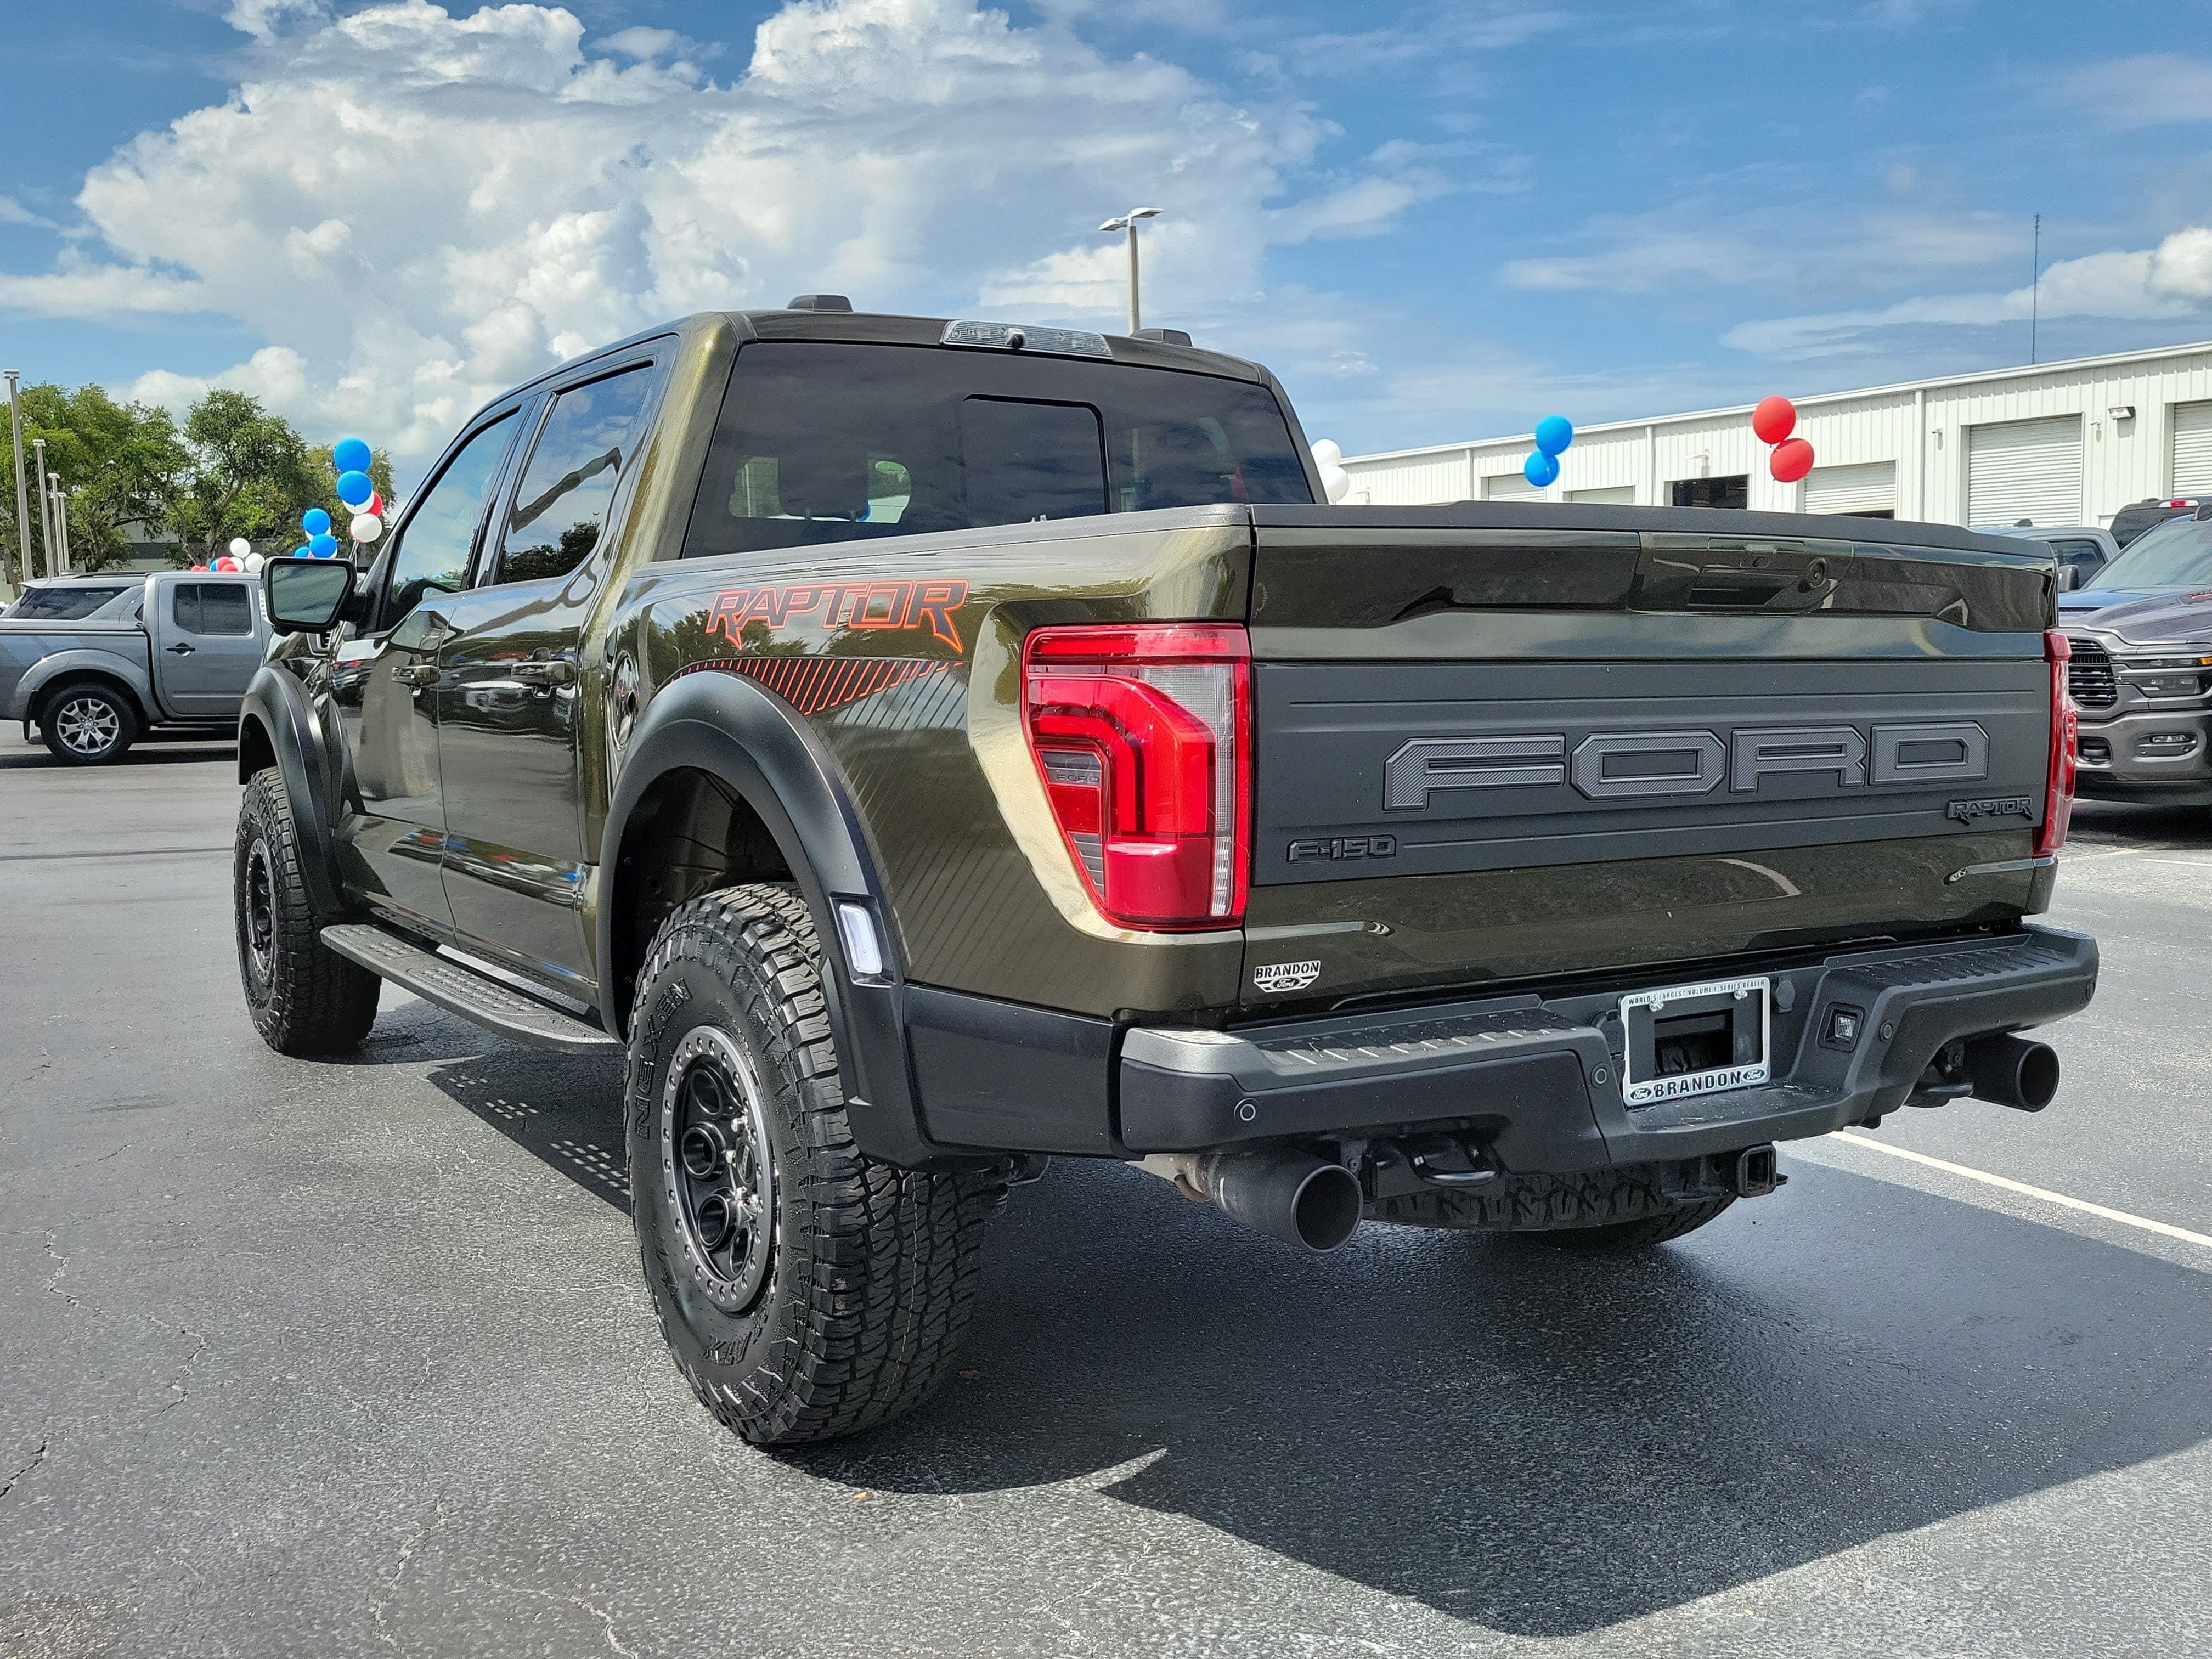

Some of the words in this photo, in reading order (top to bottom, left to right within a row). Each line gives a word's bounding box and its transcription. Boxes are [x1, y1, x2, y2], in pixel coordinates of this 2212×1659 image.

[706, 579, 970, 653] RAPTOR
[1383, 721, 1989, 811] FORD
[1947, 795, 2034, 826] RAPTOR
[1287, 834, 1396, 862] F-150
[1256, 962, 1319, 978] BRANDON
[1277, 978, 1295, 988] Ford
[1629, 994, 1656, 1005] WORLDS
[1659, 989, 1687, 999] LARGEST
[1688, 986, 1712, 995] VOLUME
[1742, 980, 1764, 988] DEALER
[635, 978, 693, 1139] NEXEN
[1654, 1071, 1741, 1098] BRANDON
